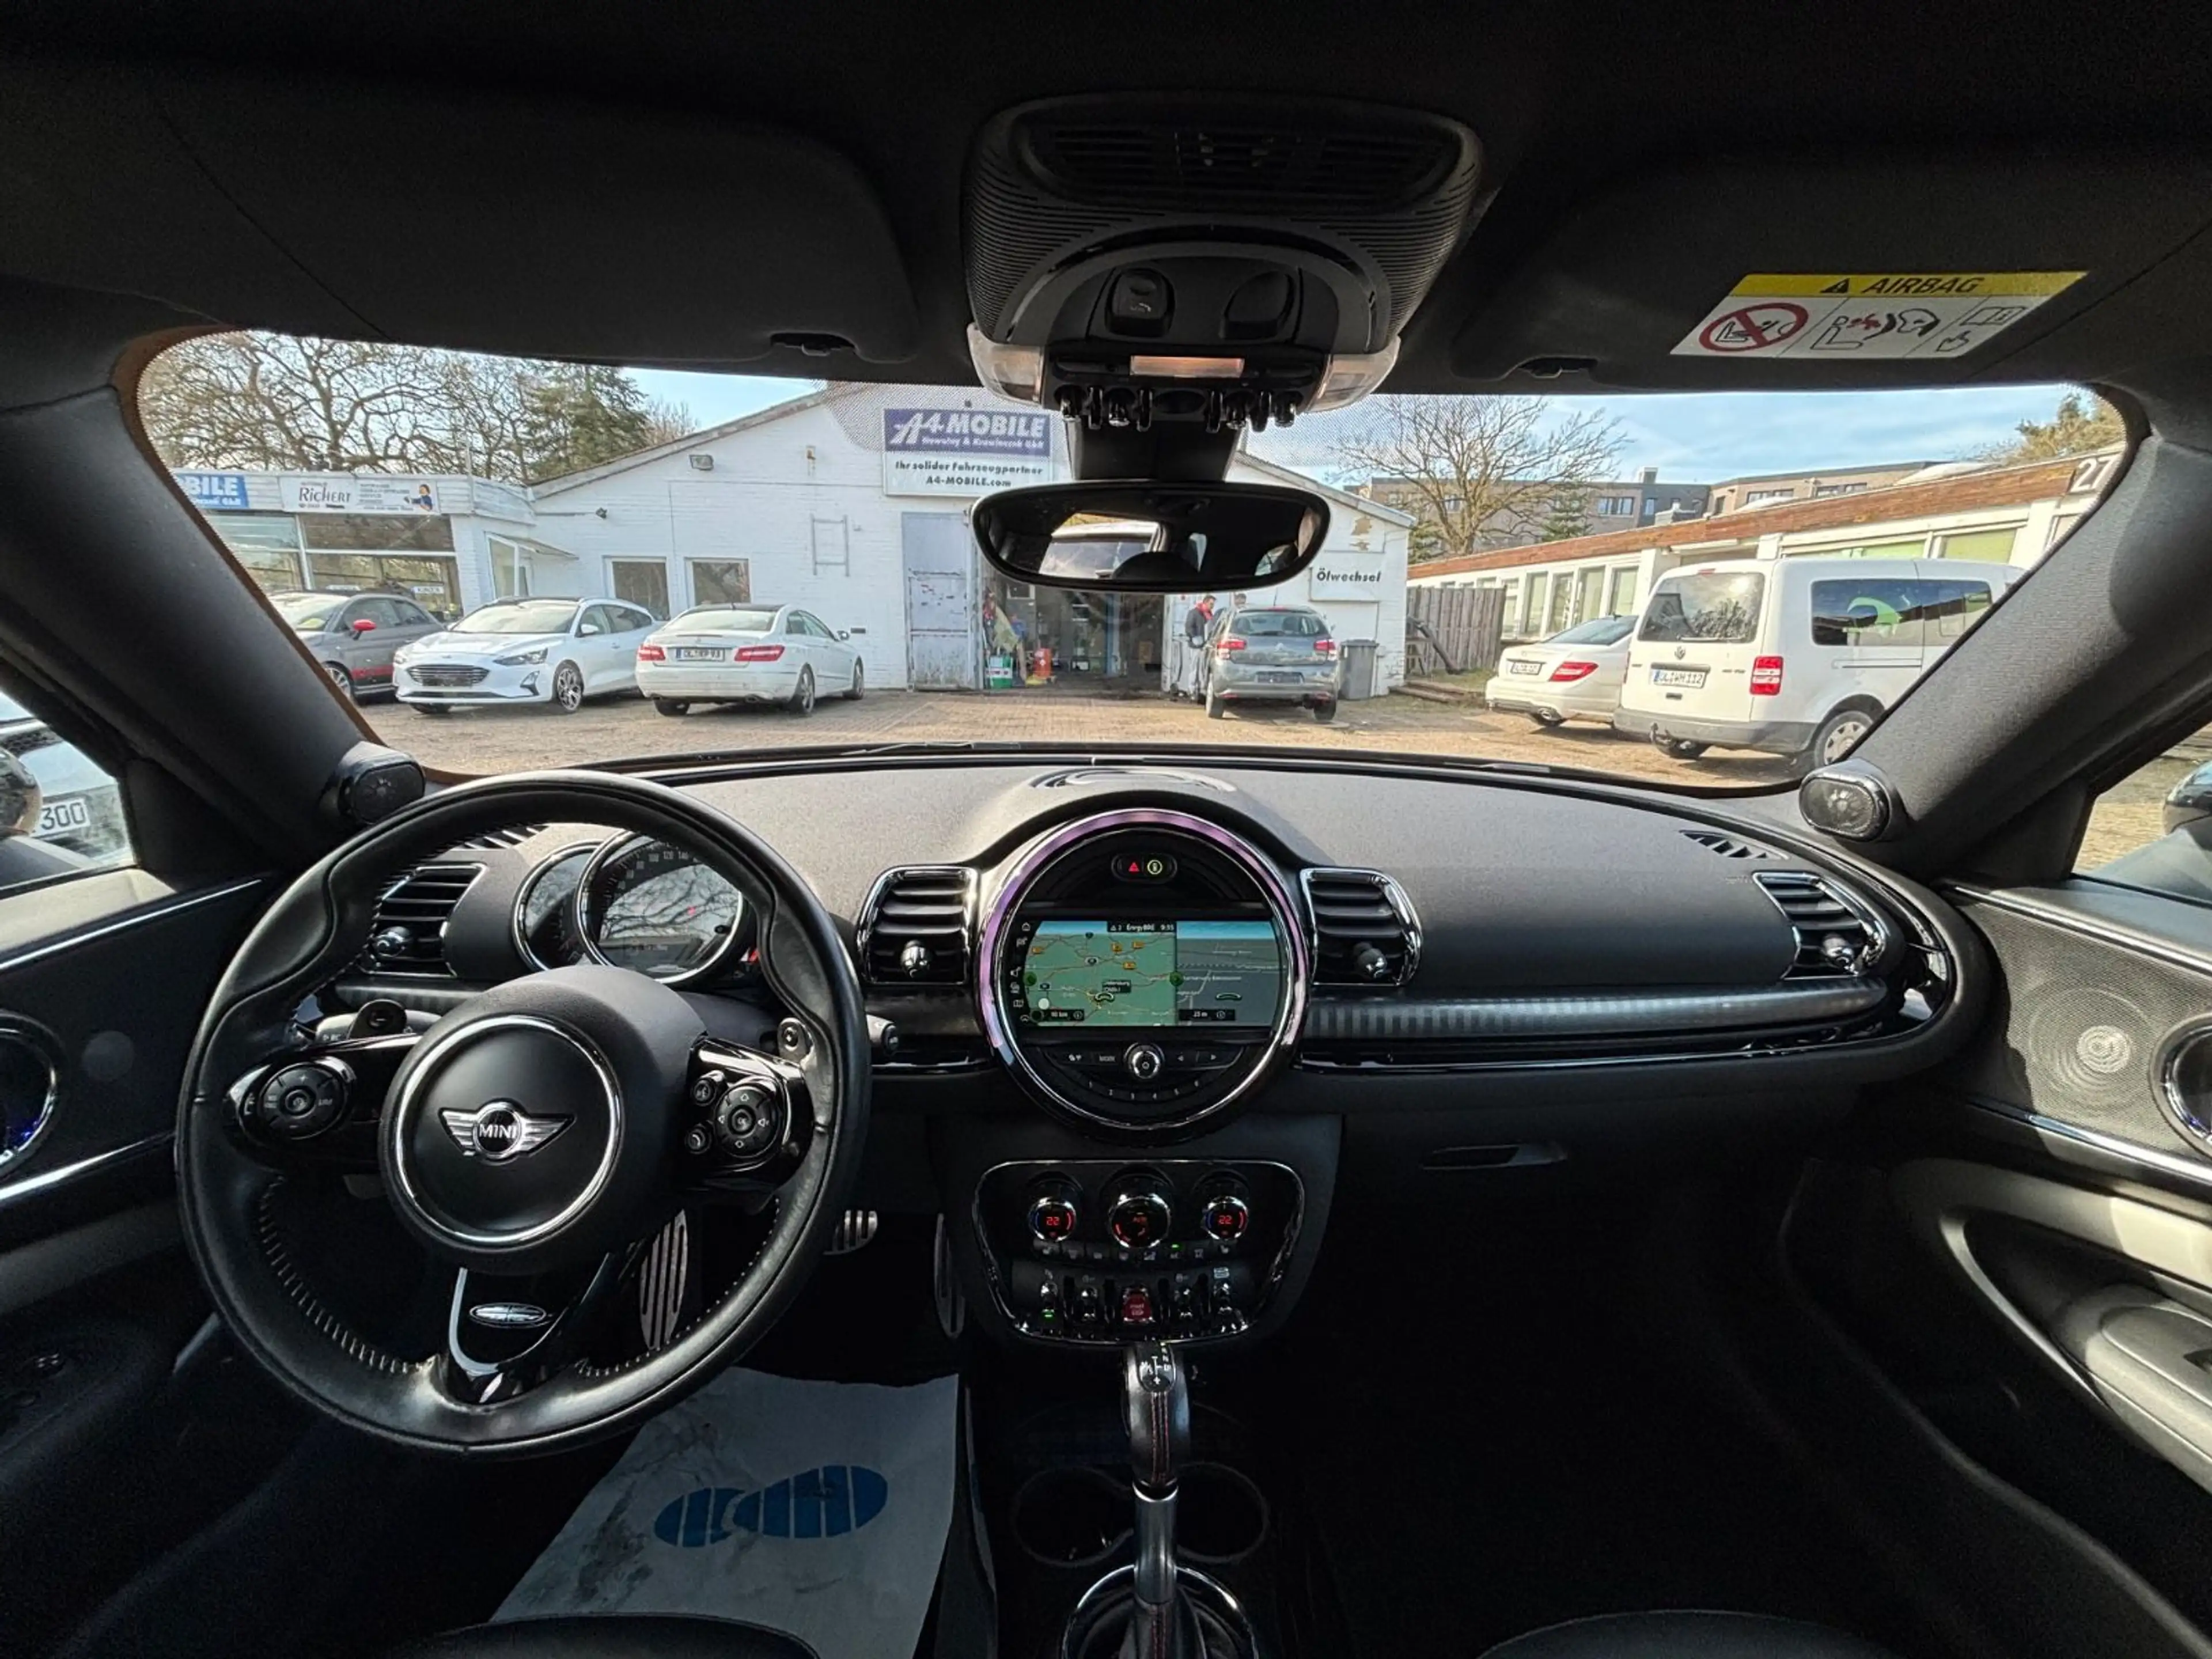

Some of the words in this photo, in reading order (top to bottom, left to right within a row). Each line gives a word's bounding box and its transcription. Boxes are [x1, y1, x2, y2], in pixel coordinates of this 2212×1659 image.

[1861, 277, 1984, 294] AIRBAG
[895, 461, 910, 469] Ihr
[2070, 454, 2122, 493] 27
[1317, 567, 1382, 582] Ölwechsel
[41, 802, 86, 830] 300
[479, 1124, 517, 1138] MINI
[1046, 1217, 1060, 1226] 22
[1218, 1215, 1232, 1225] 22
